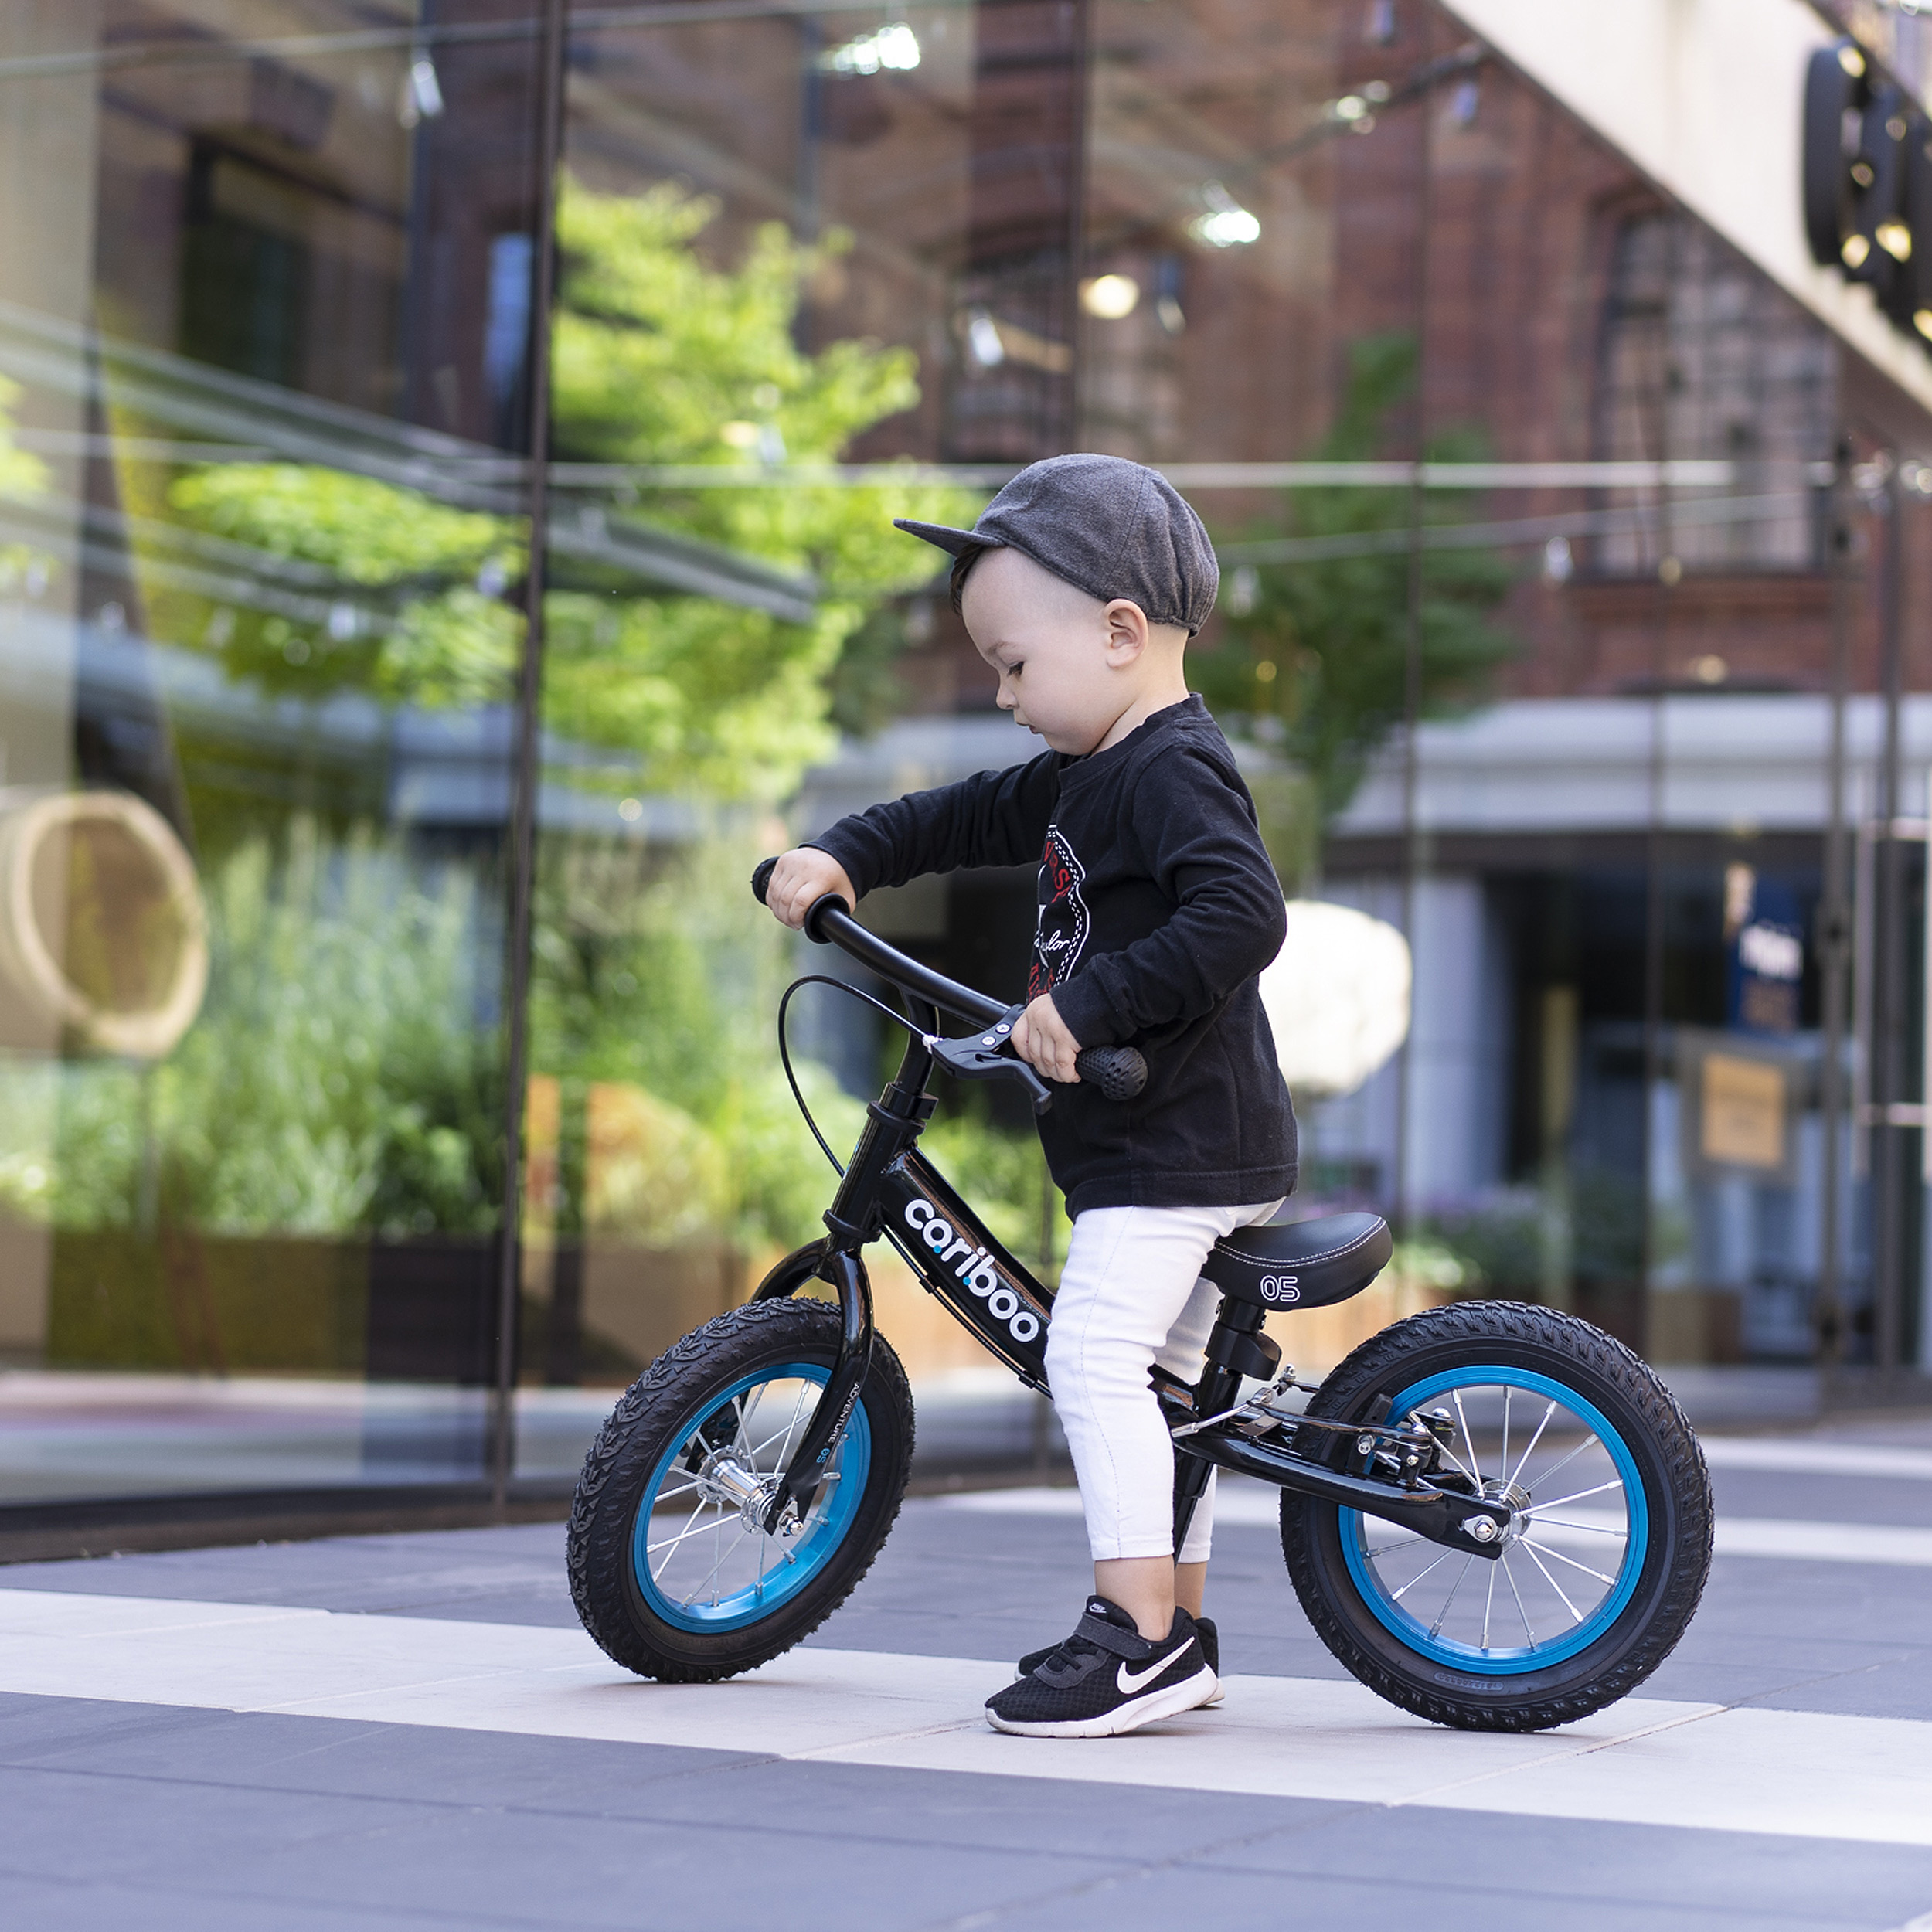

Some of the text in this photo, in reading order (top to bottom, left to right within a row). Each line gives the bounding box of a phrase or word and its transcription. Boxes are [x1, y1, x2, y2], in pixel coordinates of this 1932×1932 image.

[904, 1199, 1039, 1342] cariboo
[1260, 1275, 1301, 1302] 05
[828, 1382, 860, 1443] ADVENTURE
